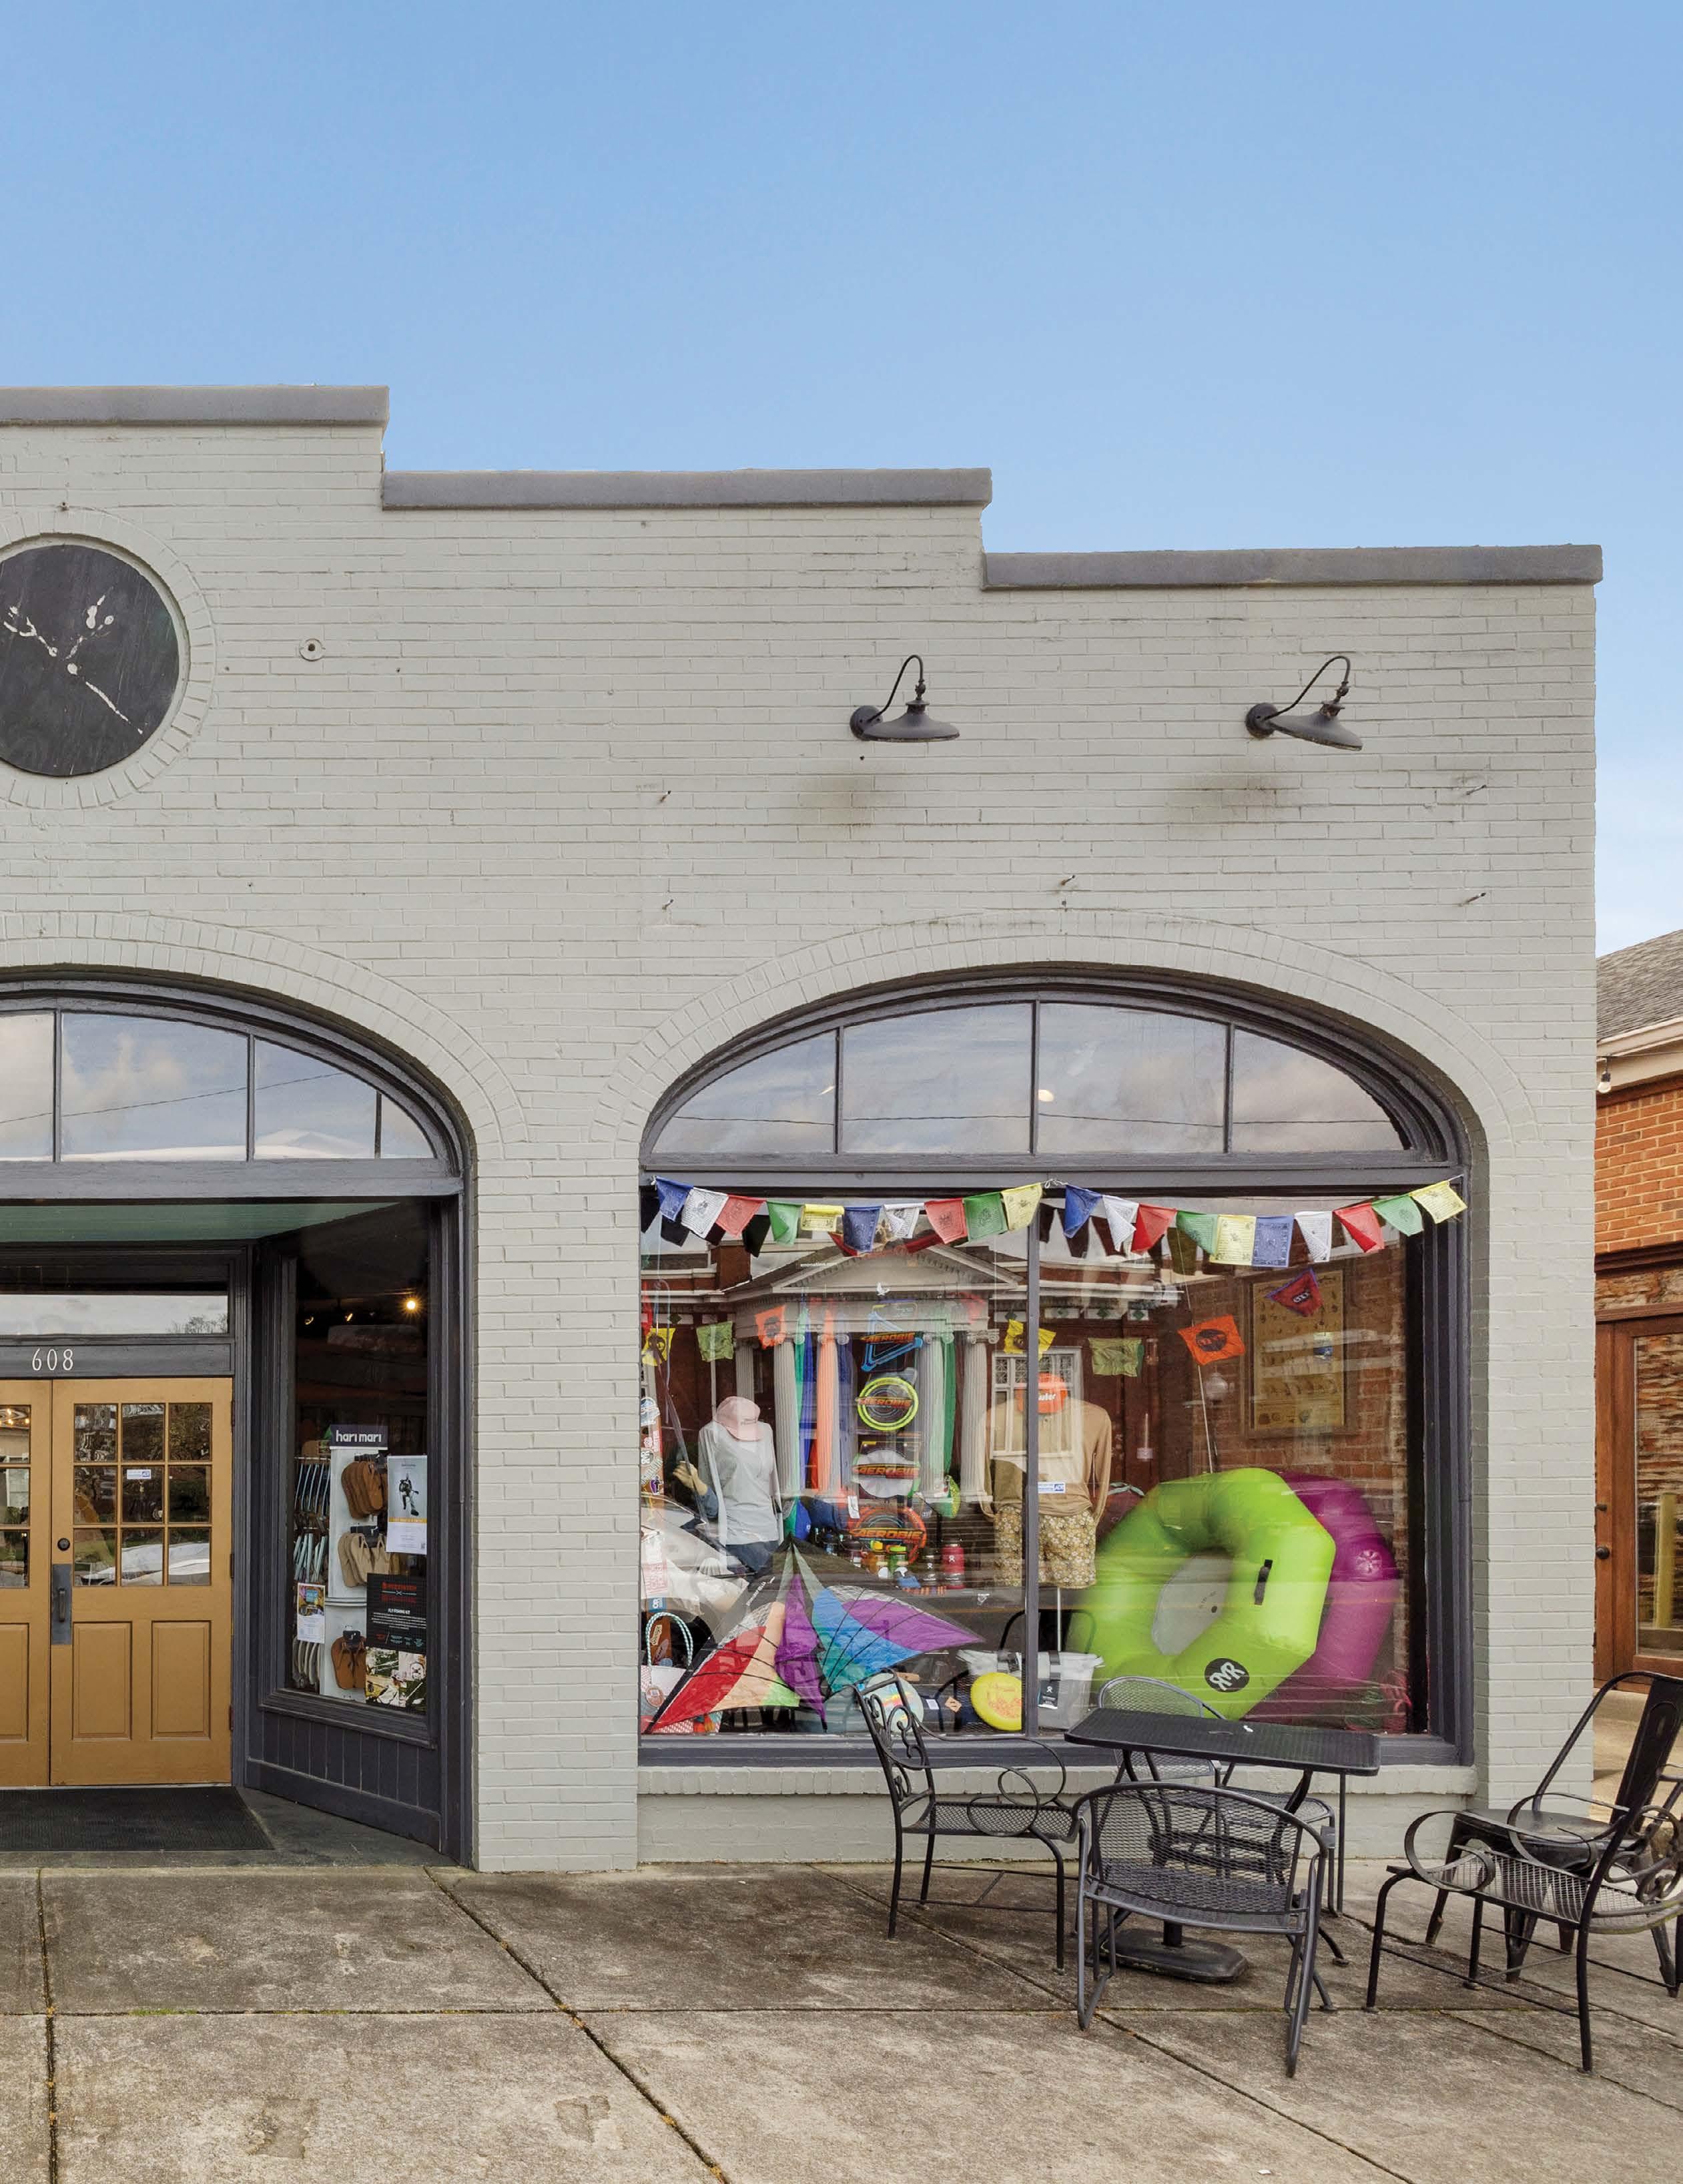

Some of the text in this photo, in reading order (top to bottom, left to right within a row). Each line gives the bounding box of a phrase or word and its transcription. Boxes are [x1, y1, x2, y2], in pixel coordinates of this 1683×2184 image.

[32, 1348, 73, 1370] 608
[336, 1430, 382, 1442] hari mari
